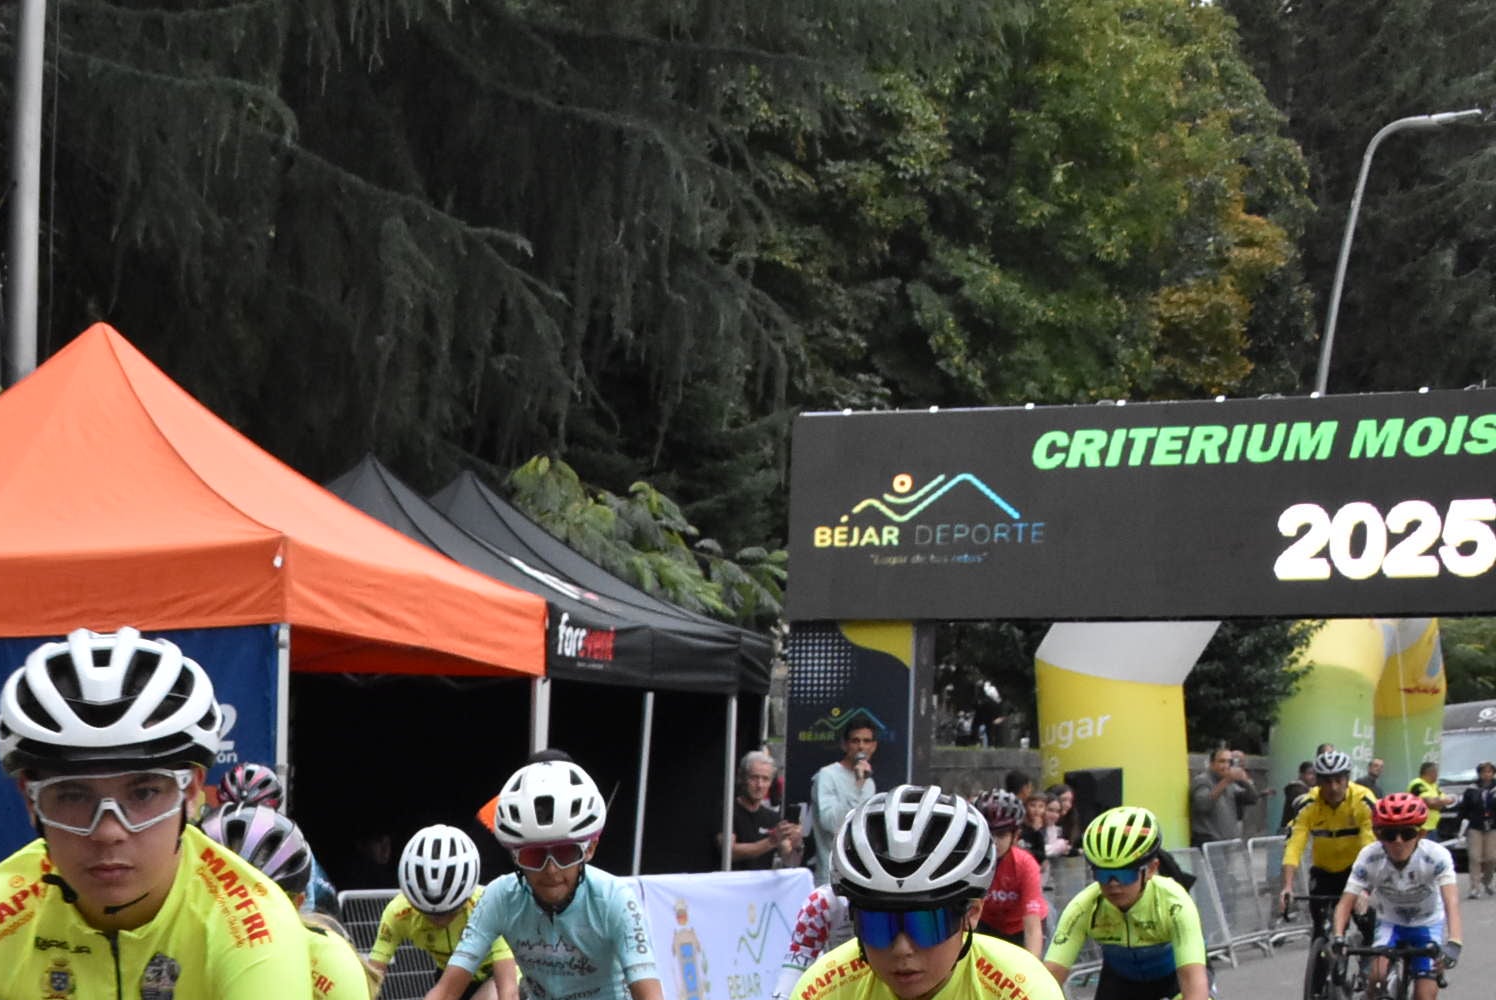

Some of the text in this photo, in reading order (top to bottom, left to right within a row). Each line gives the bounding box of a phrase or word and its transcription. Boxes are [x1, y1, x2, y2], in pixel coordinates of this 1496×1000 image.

[1032, 414, 1496, 470] CRITERIUM MOIS
[914, 521, 1045, 546] DEPORTE
[1273, 498, 1496, 581] 2025
[200, 848, 272, 947] MAPFRE
